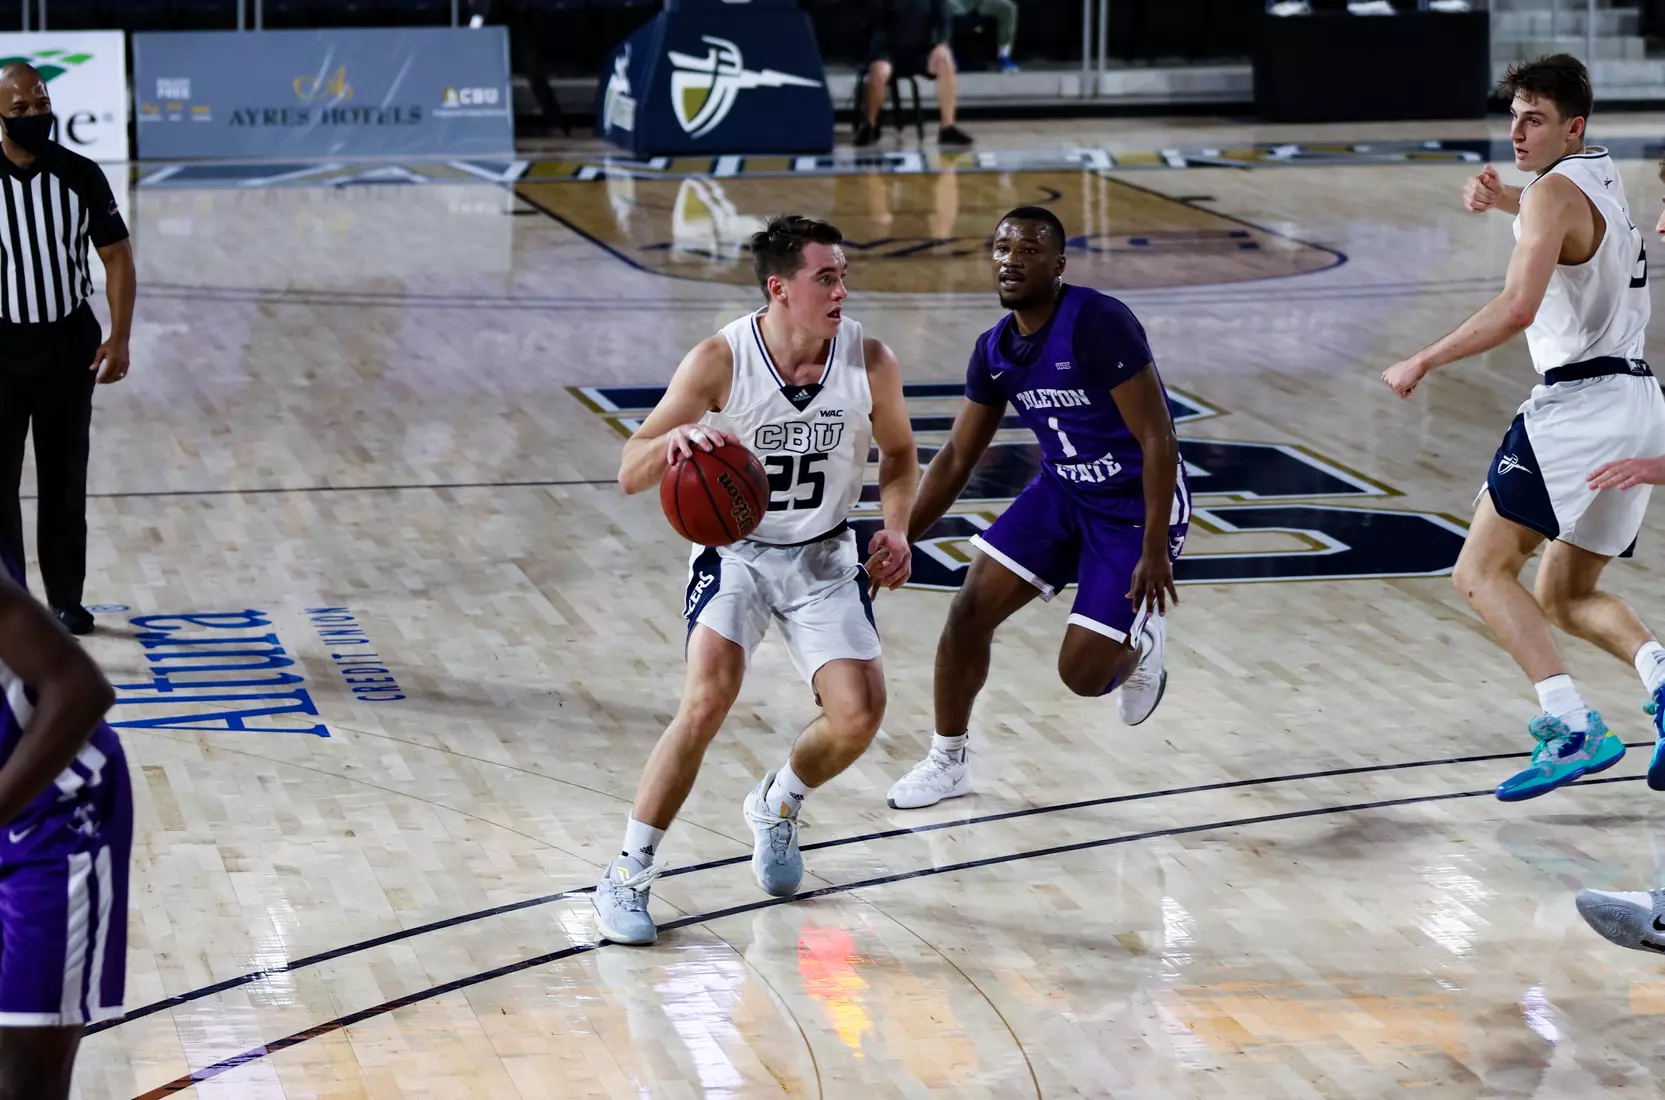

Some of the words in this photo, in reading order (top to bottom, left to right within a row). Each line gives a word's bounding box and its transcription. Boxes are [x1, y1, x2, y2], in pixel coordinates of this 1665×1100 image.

[229, 106, 311, 127] AYRES
[320, 105, 423, 126] HOTELS
[820, 409, 843, 417] WAC
[754, 421, 844, 454] CBU
[1048, 416, 1077, 458] 1
[765, 452, 828, 512] 25
[304, 607, 370, 646] UNION
[331, 652, 406, 701] CREDIT
